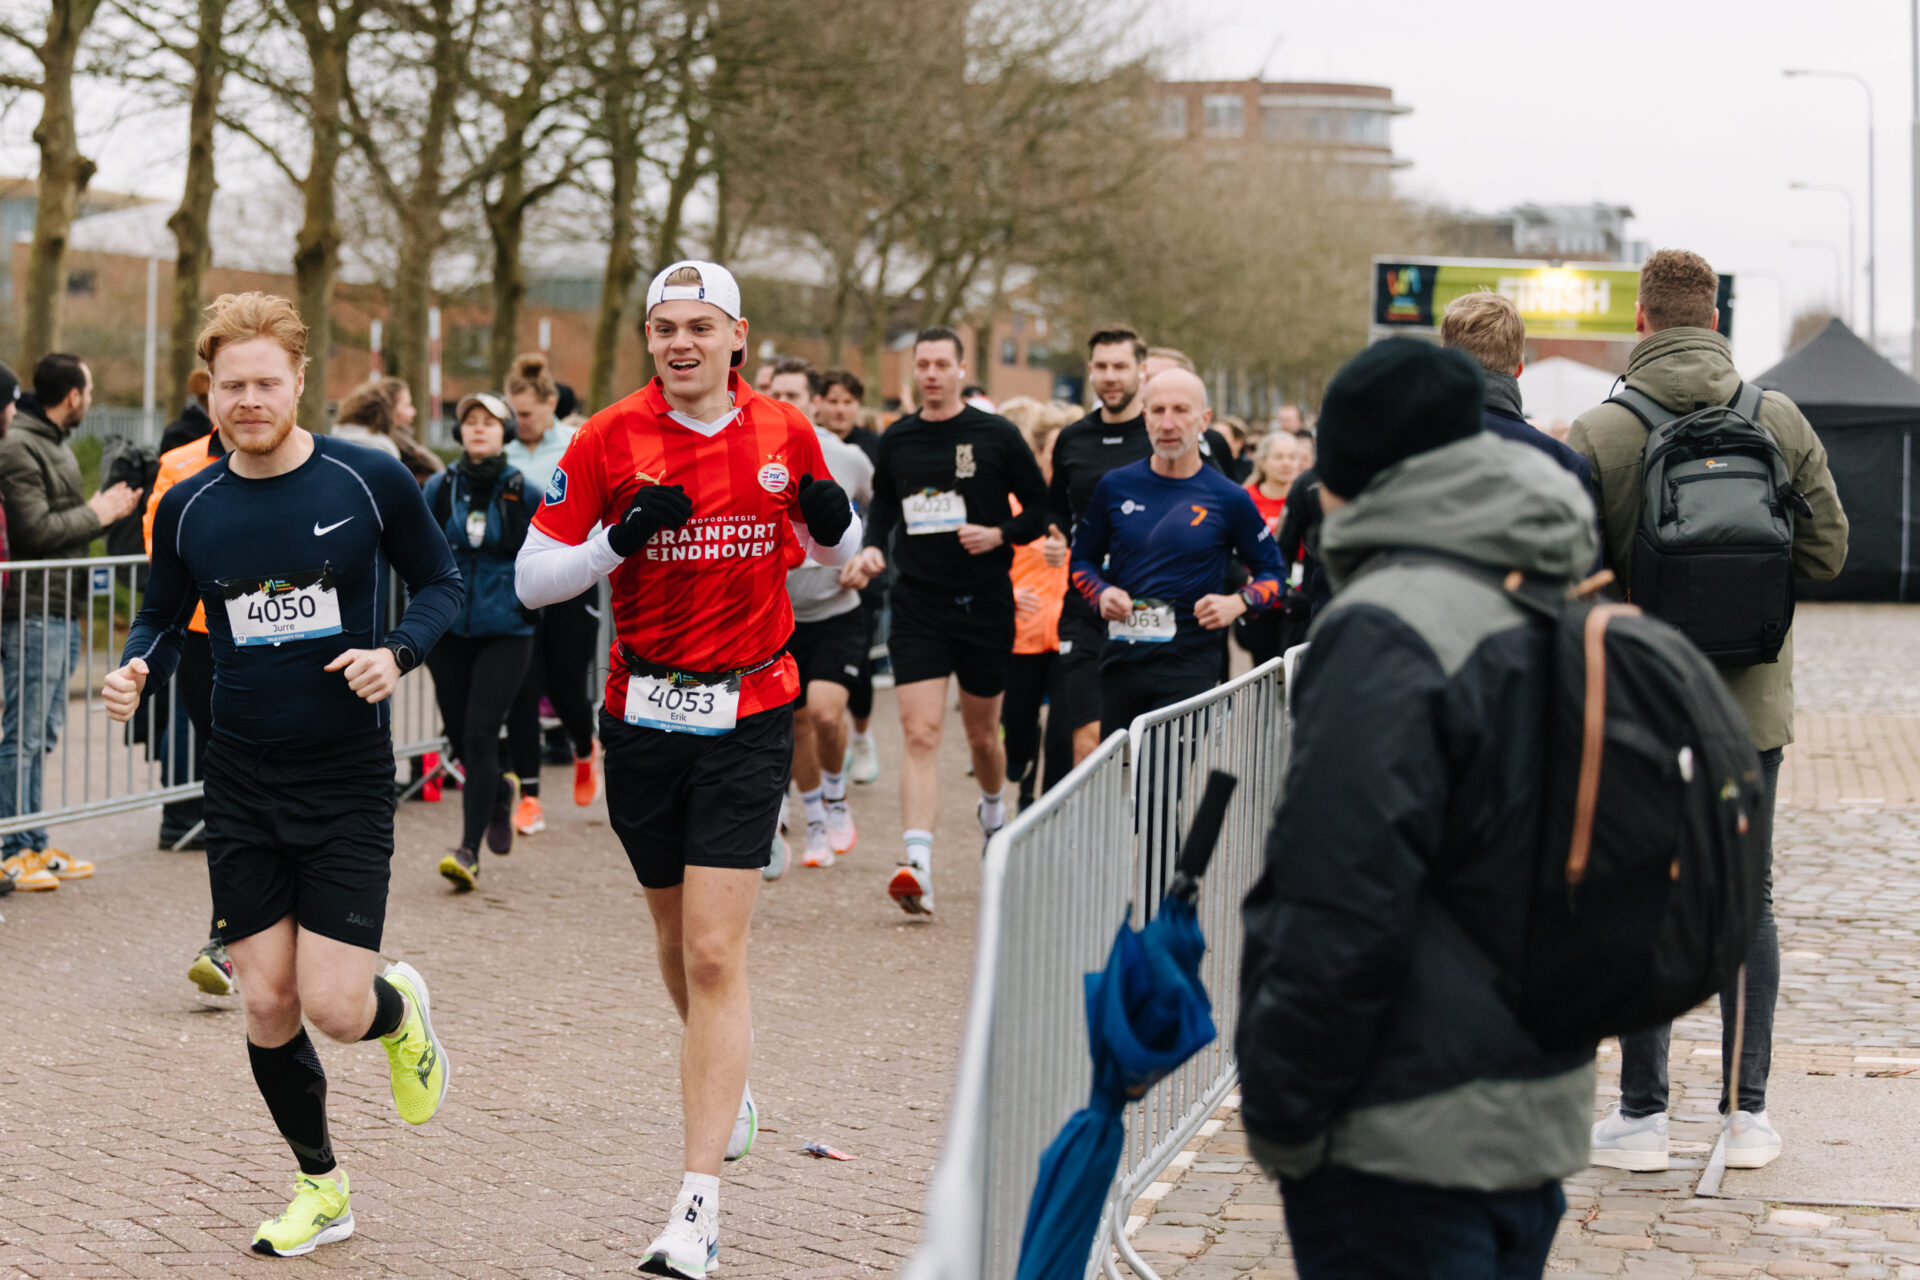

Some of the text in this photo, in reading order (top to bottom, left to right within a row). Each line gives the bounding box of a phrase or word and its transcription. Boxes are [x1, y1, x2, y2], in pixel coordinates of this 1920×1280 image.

[1497, 276, 1611, 315] FINISH
[913, 499, 952, 513] 4023
[646, 522, 777, 545] BRAINPORT
[646, 540, 775, 562] EINDHOVEN
[247, 595, 316, 624] 4050
[272, 623, 295, 633] Jurre
[1124, 611, 1161, 629] 063
[647, 685, 715, 715] 4053
[670, 712, 687, 722] Erik
[345, 911, 375, 929] JAKO
